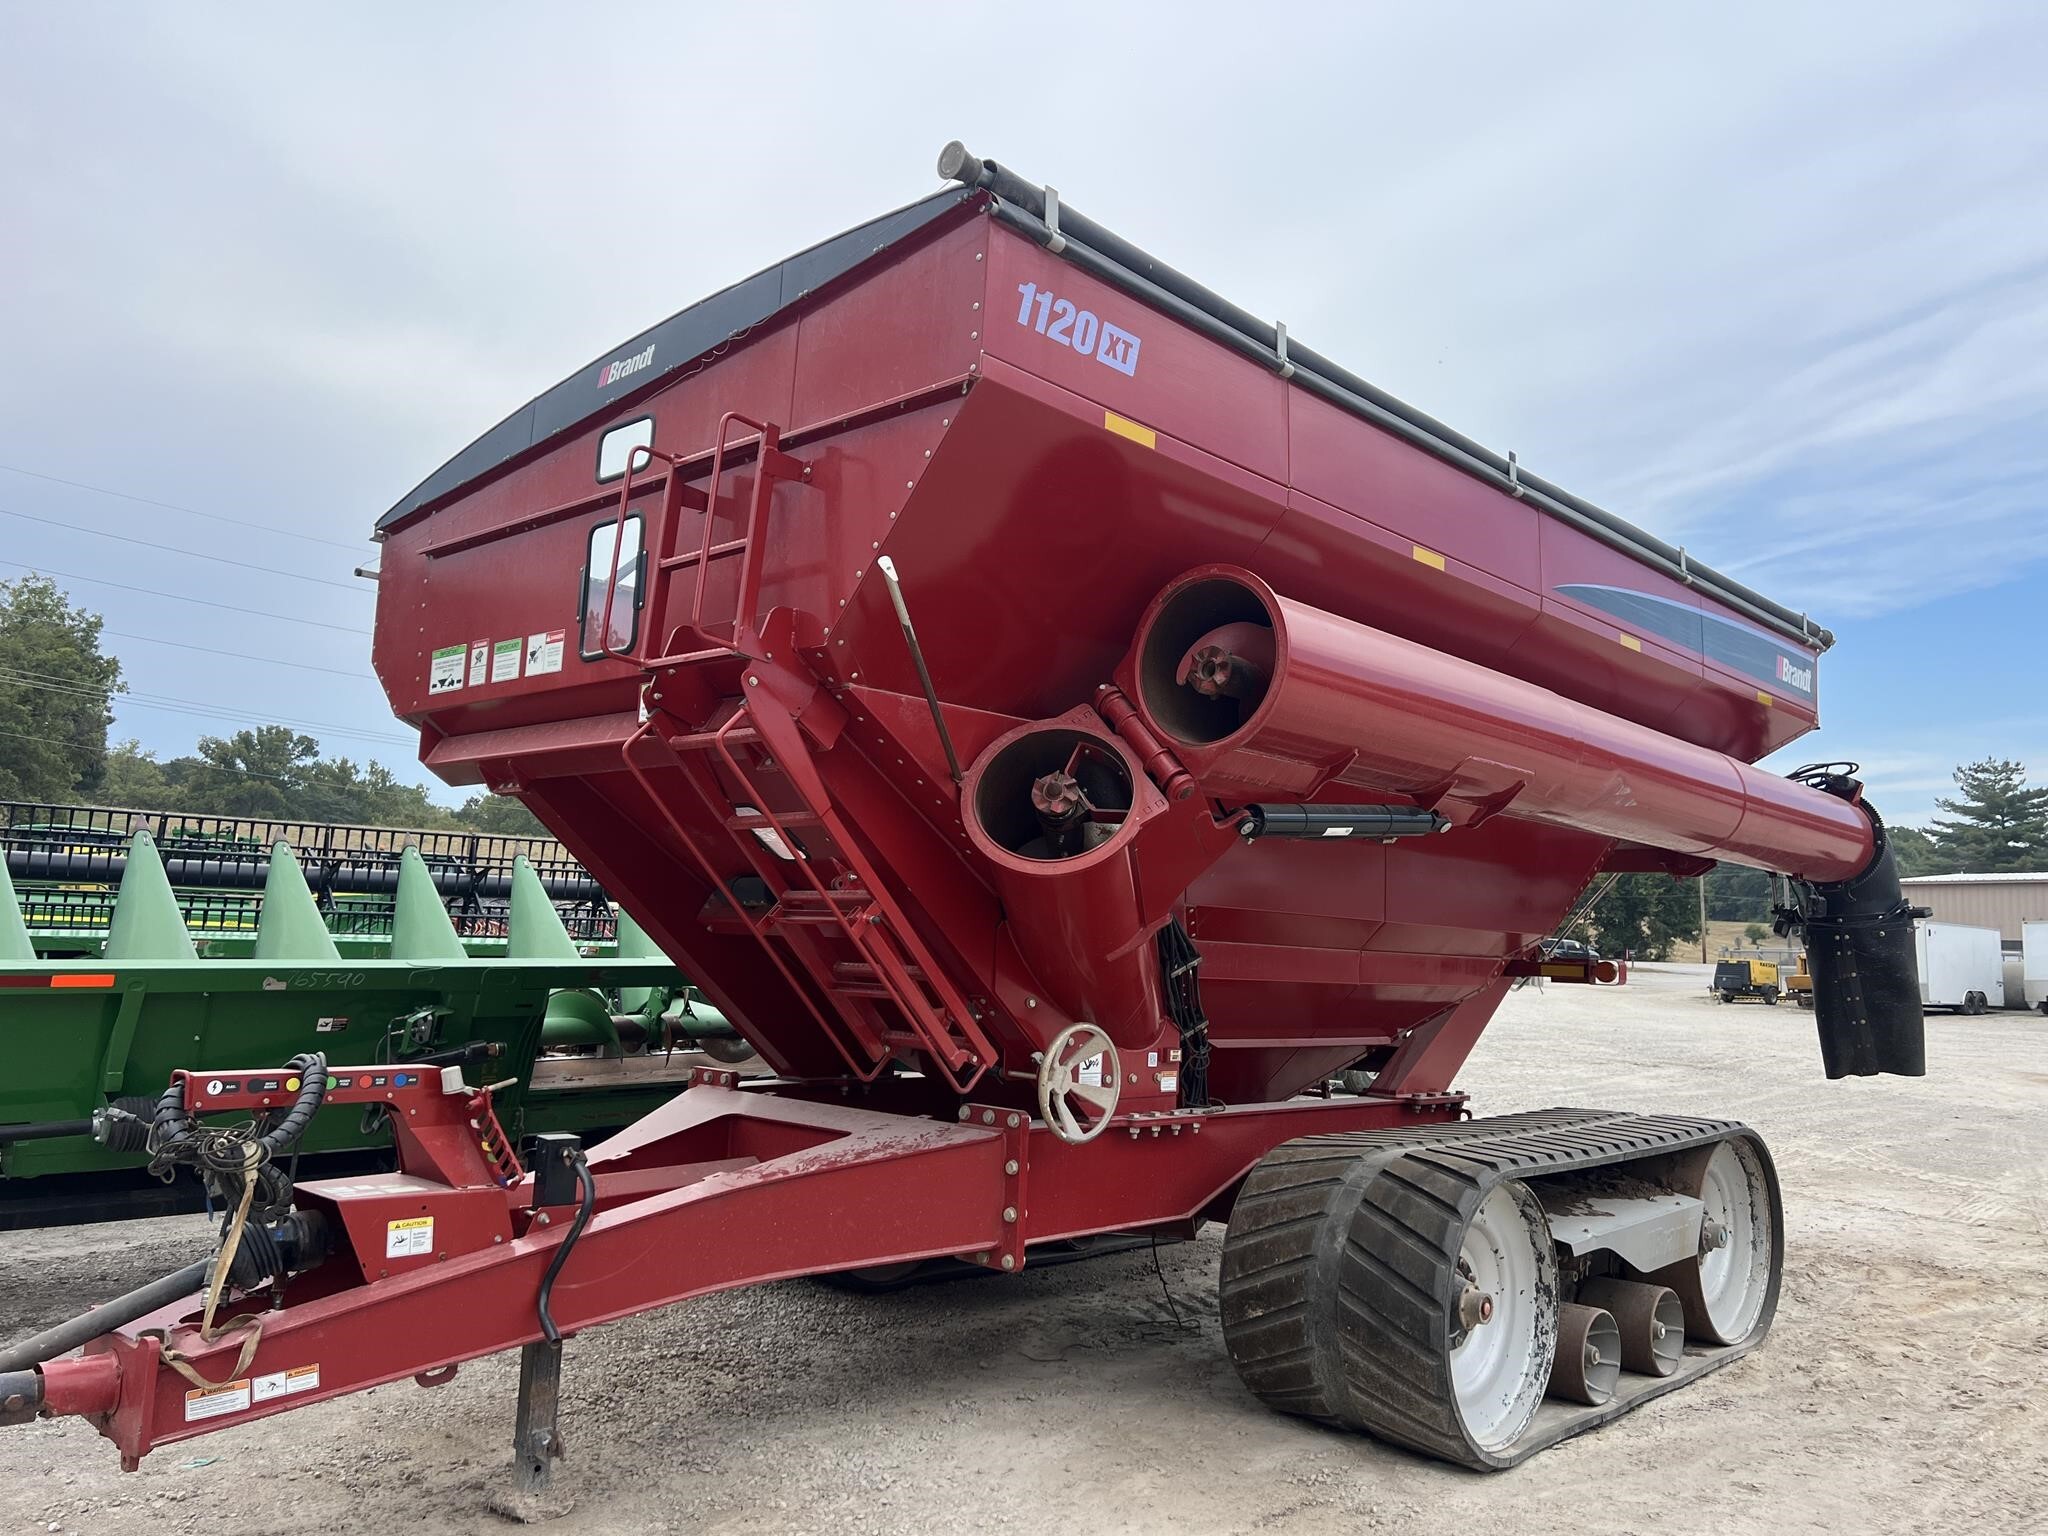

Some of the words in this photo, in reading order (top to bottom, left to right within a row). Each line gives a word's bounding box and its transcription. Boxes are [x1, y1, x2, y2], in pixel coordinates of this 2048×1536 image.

[1017, 282, 1098, 355] 1120
[1104, 332, 1133, 365] XT
[607, 344, 655, 385] Brandt
[1783, 657, 1811, 693] Brandt
[402, 1220, 428, 1228] CAUTION
